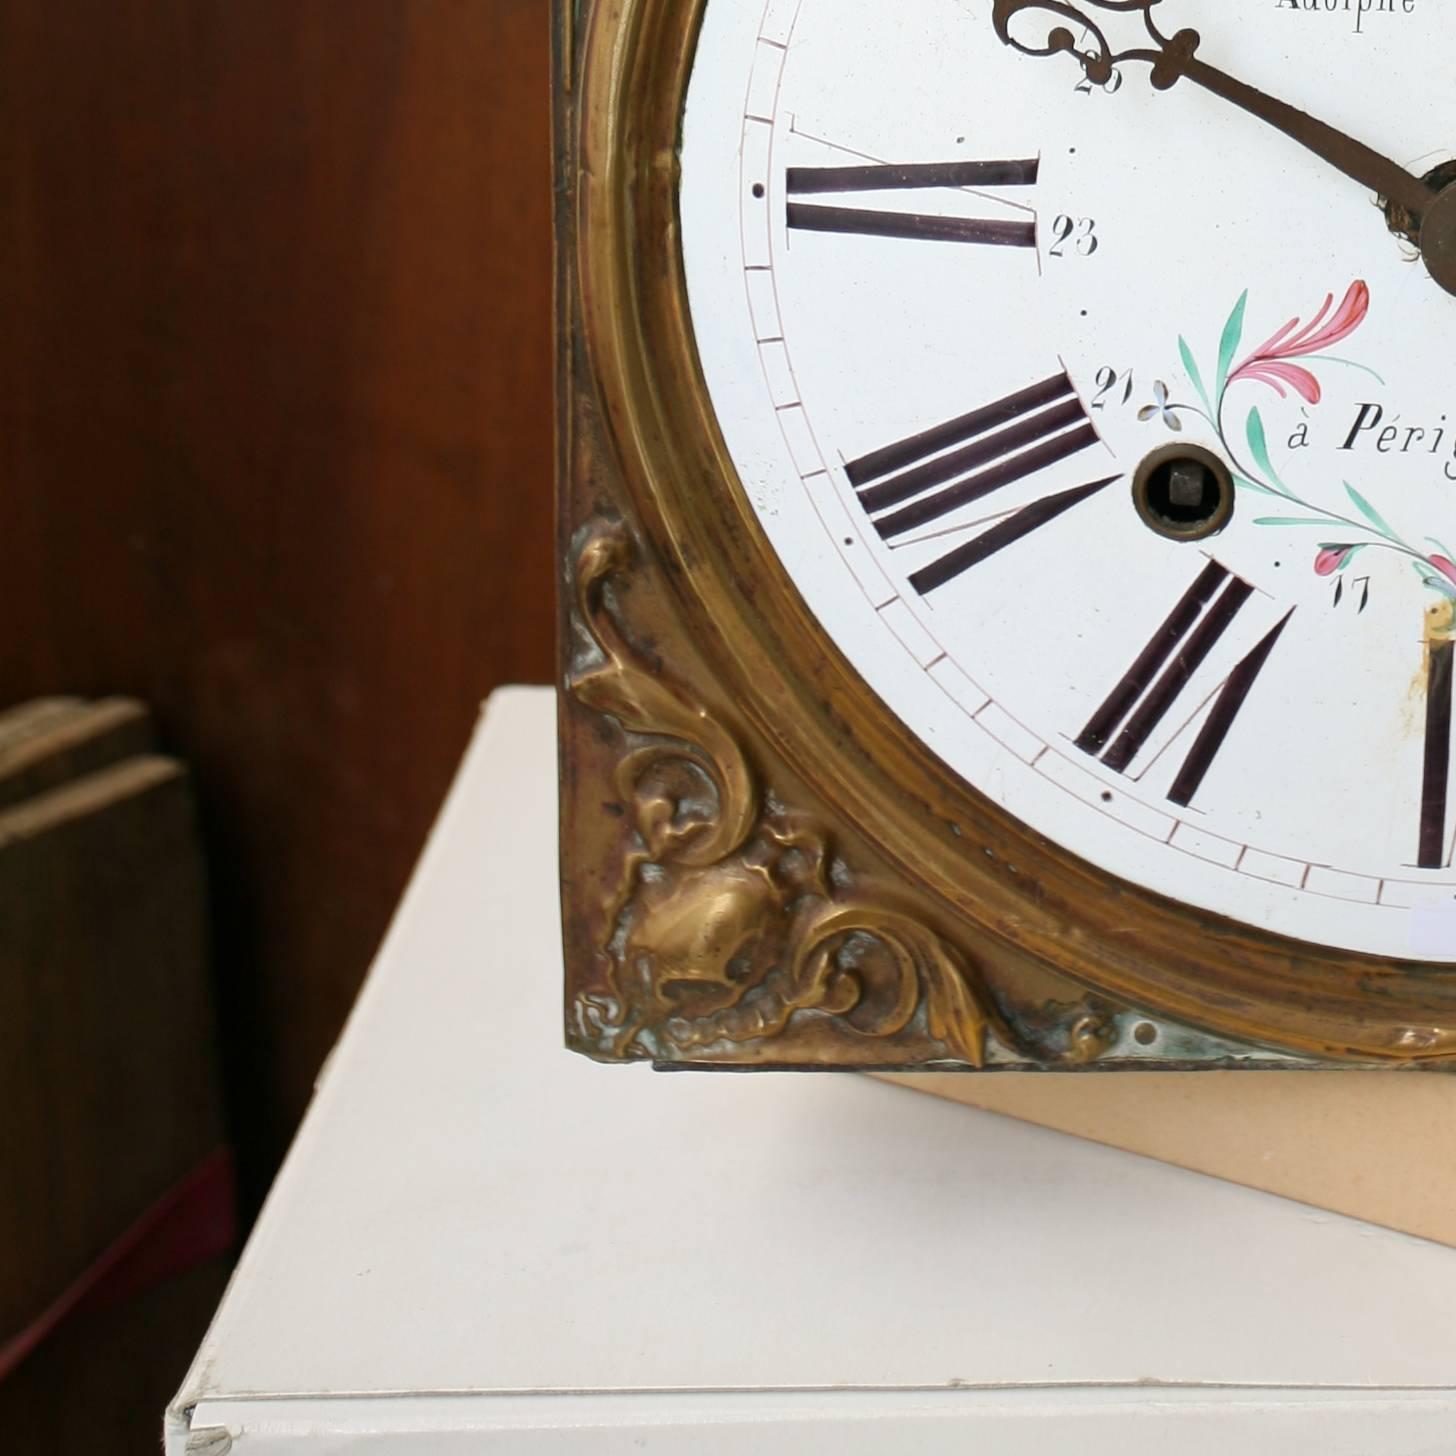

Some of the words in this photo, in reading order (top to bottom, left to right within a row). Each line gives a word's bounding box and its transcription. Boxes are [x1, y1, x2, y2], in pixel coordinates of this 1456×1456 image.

[1049, 214, 1099, 258] 23
[1091, 366, 1134, 409] 21
[1287, 406, 1310, 449] à
